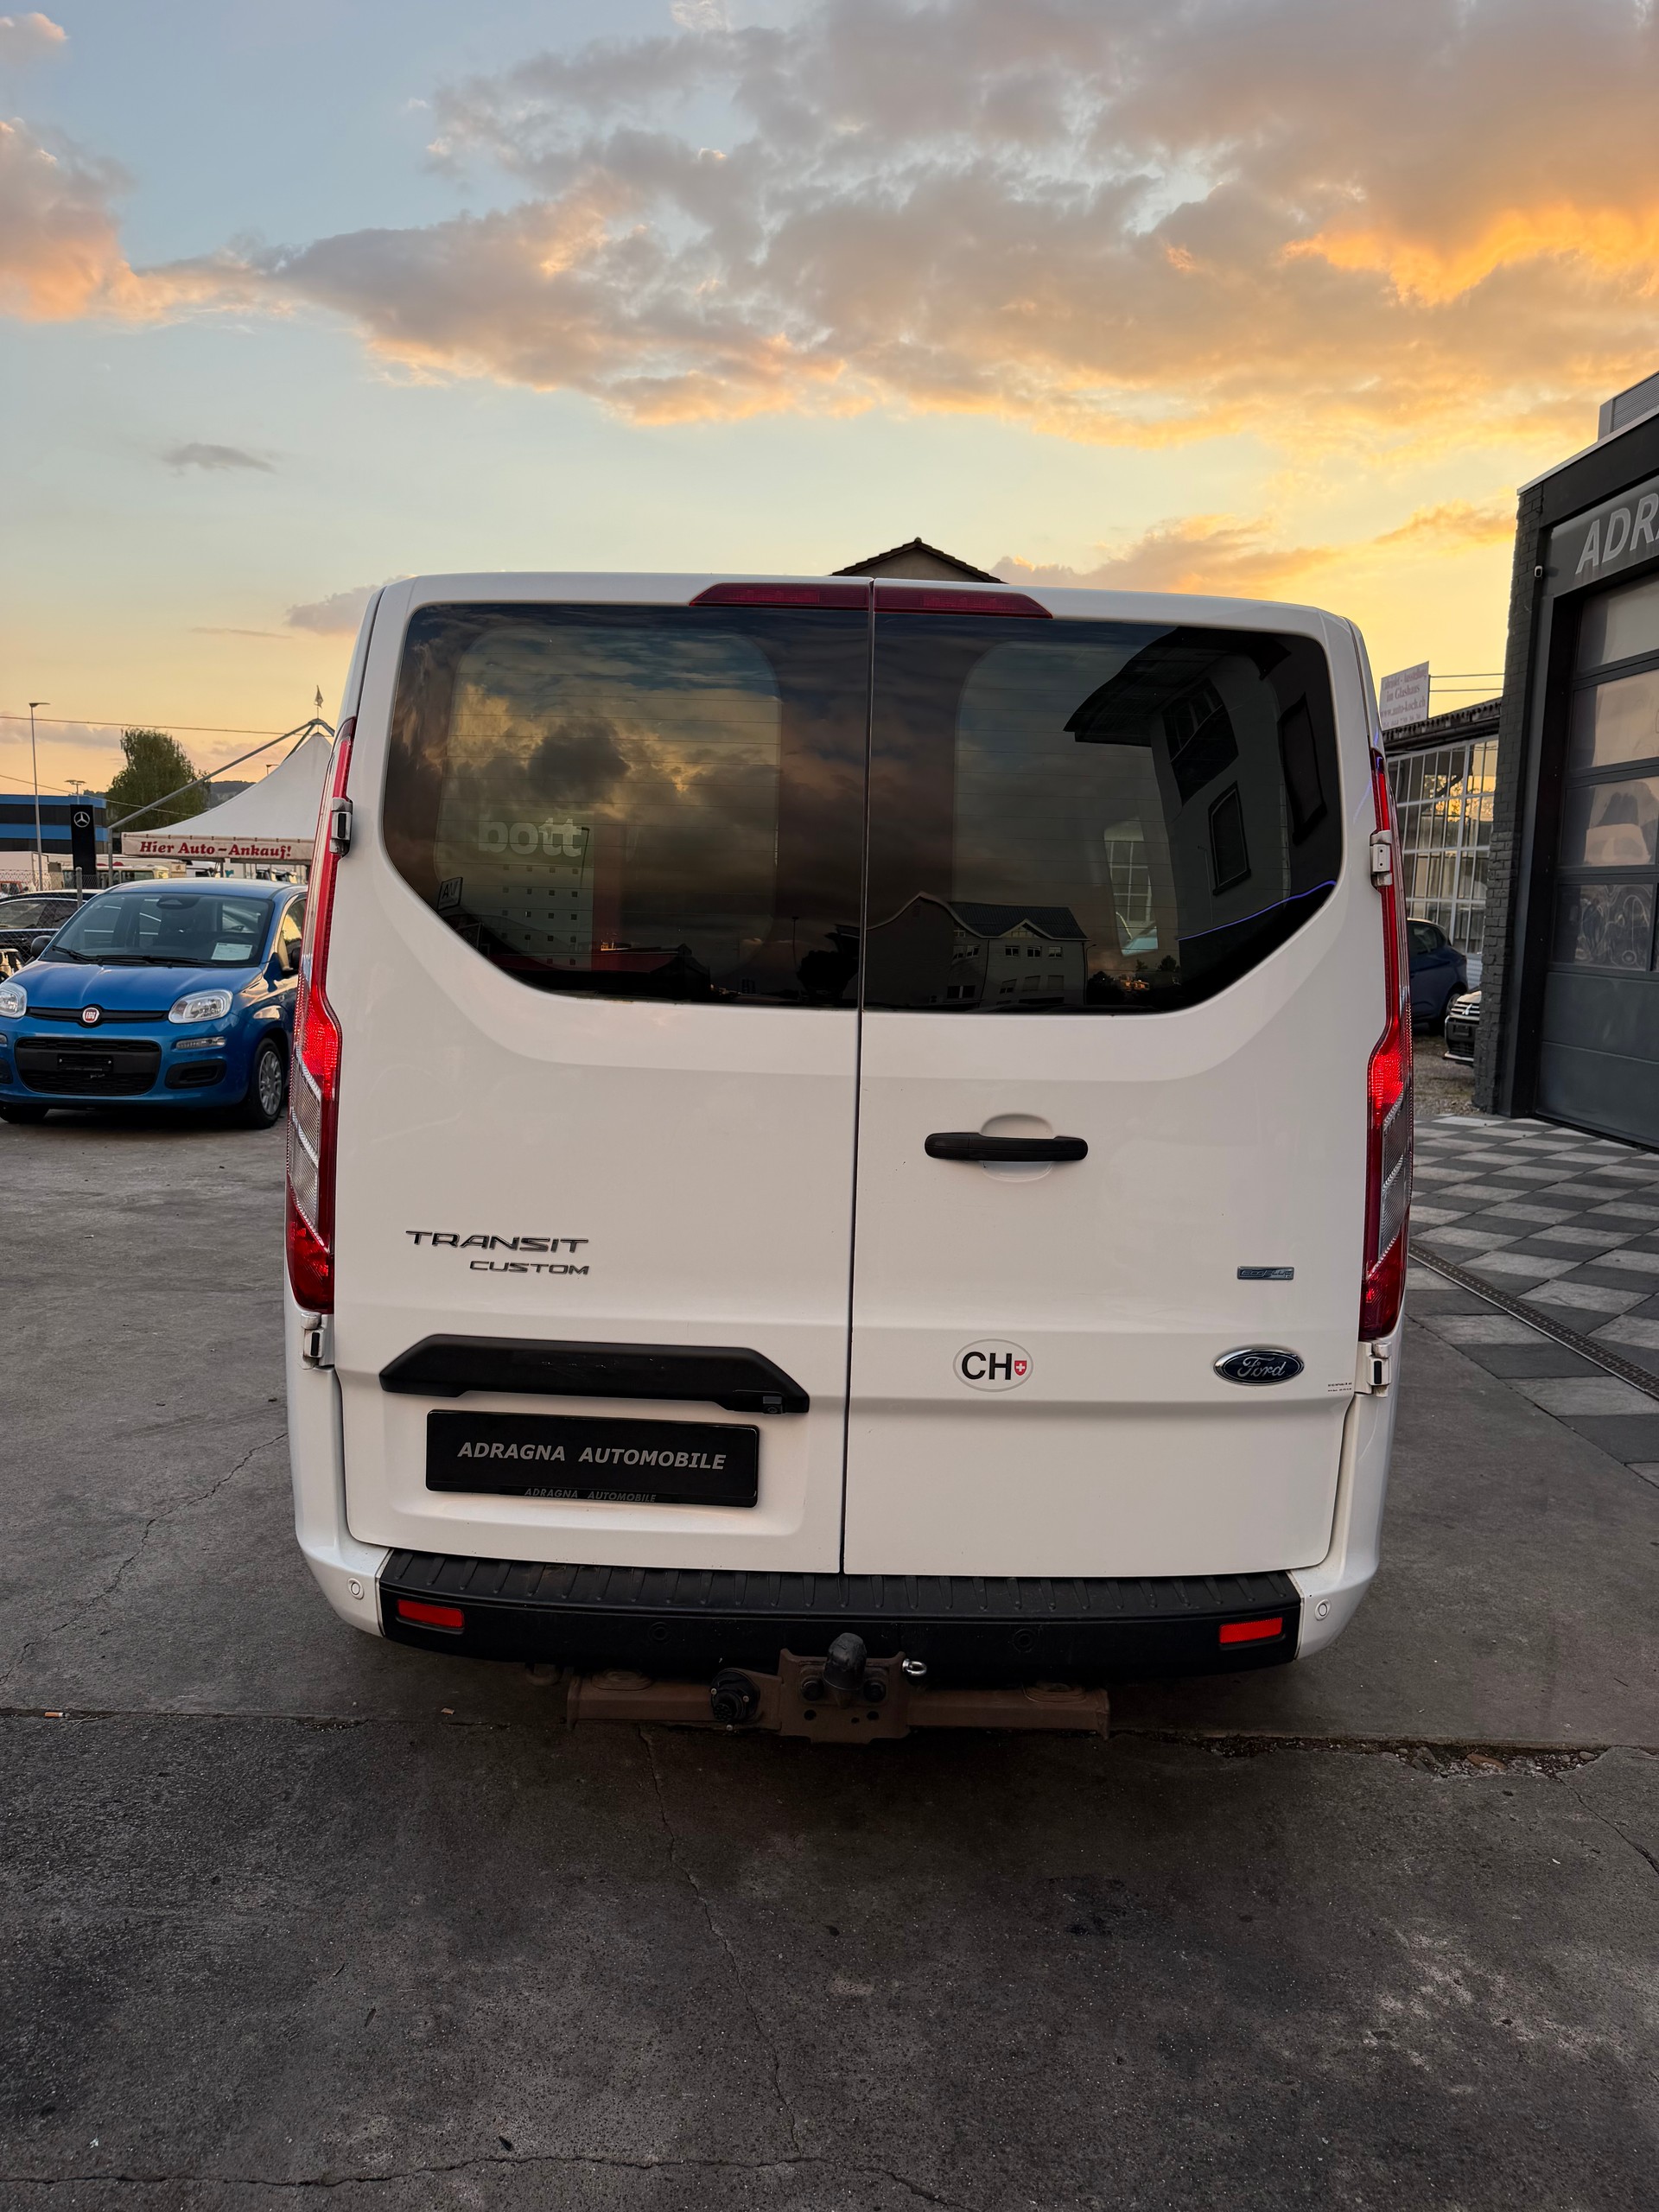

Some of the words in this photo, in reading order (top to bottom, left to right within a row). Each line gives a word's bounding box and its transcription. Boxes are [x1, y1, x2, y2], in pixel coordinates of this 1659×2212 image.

[1575, 493, 1659, 575] ADR
[478, 811, 582, 857] bott
[140, 841, 175, 854] Hier
[178, 842, 215, 855] Auto
[405, 1230, 589, 1254] TRANSIT
[469, 1260, 590, 1275] CUSTOM
[961, 1351, 1013, 1380] CH
[1236, 1356, 1287, 1377] Ford
[457, 1442, 566, 1461] ADRAGNA
[578, 1447, 727, 1470] AUTOMOBILE
[524, 1488, 579, 1499] ADRAGNA
[587, 1491, 657, 1503] AUTOMOBILE
